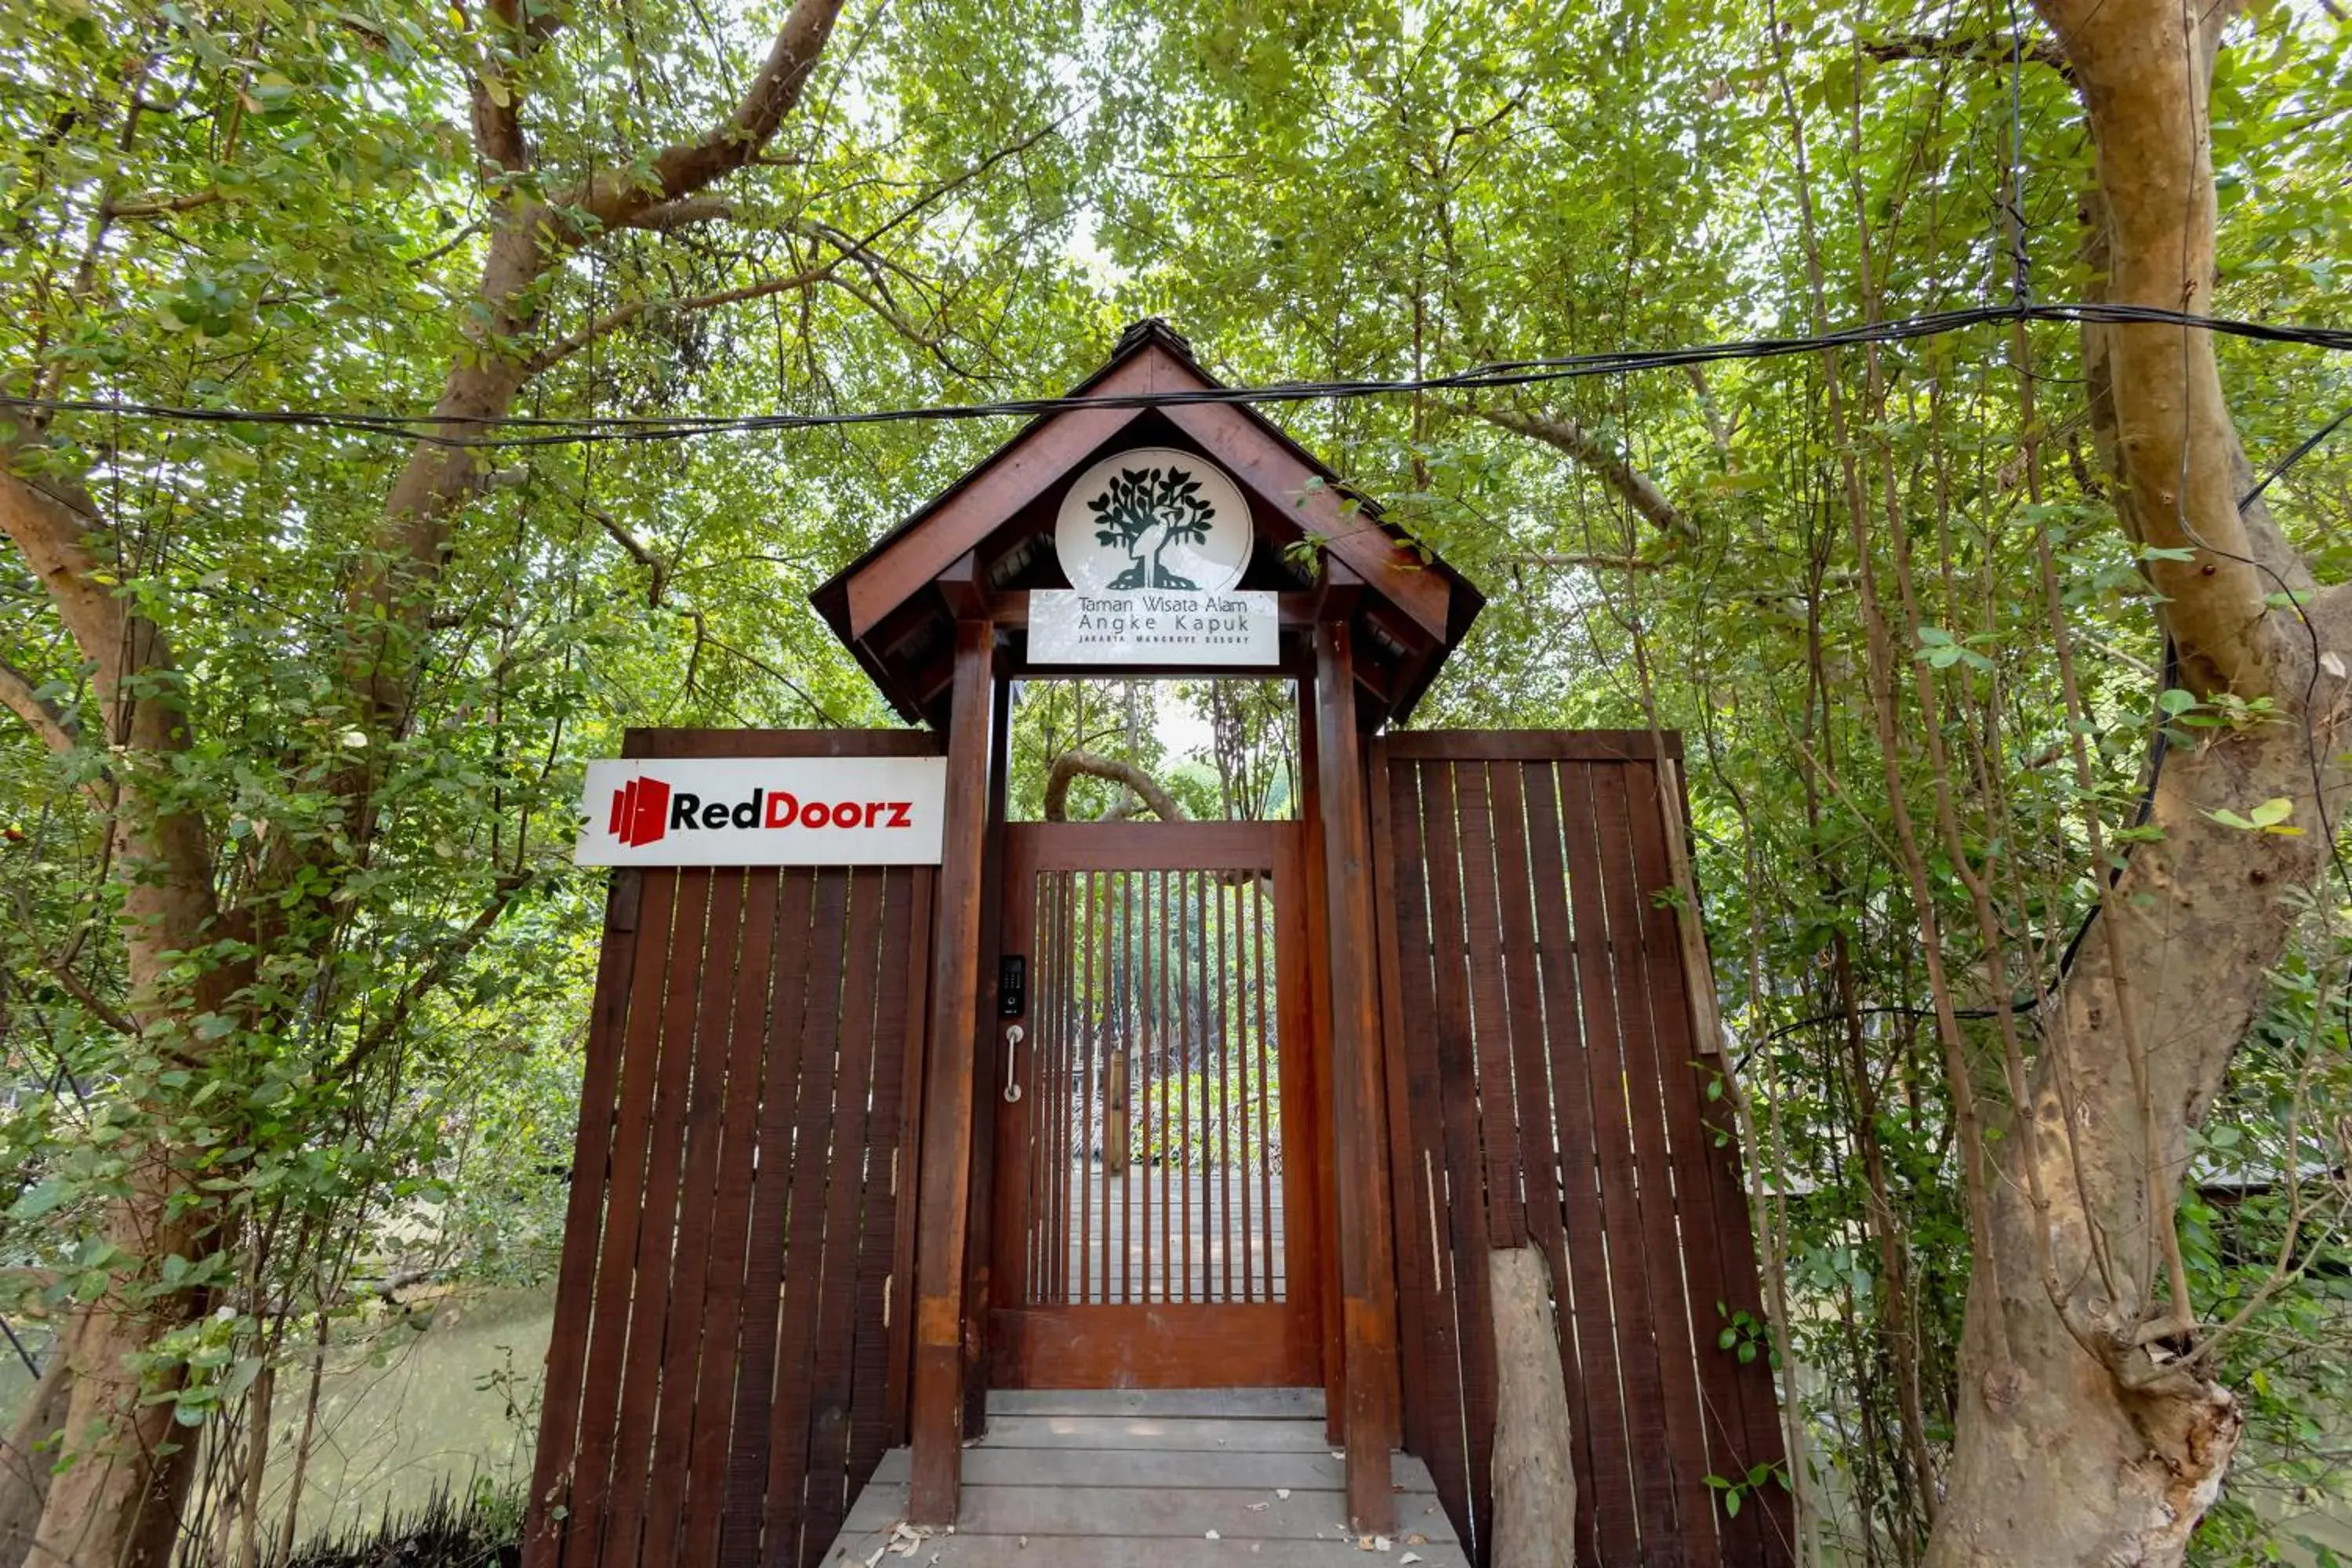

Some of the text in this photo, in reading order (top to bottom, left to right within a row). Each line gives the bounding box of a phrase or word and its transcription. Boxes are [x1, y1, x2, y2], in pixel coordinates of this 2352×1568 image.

[1079, 597, 1247, 612] Taman Wisata Alam
[1079, 615, 1249, 633] Angke Kapuk
[670, 788, 913, 829] RedDoorz
